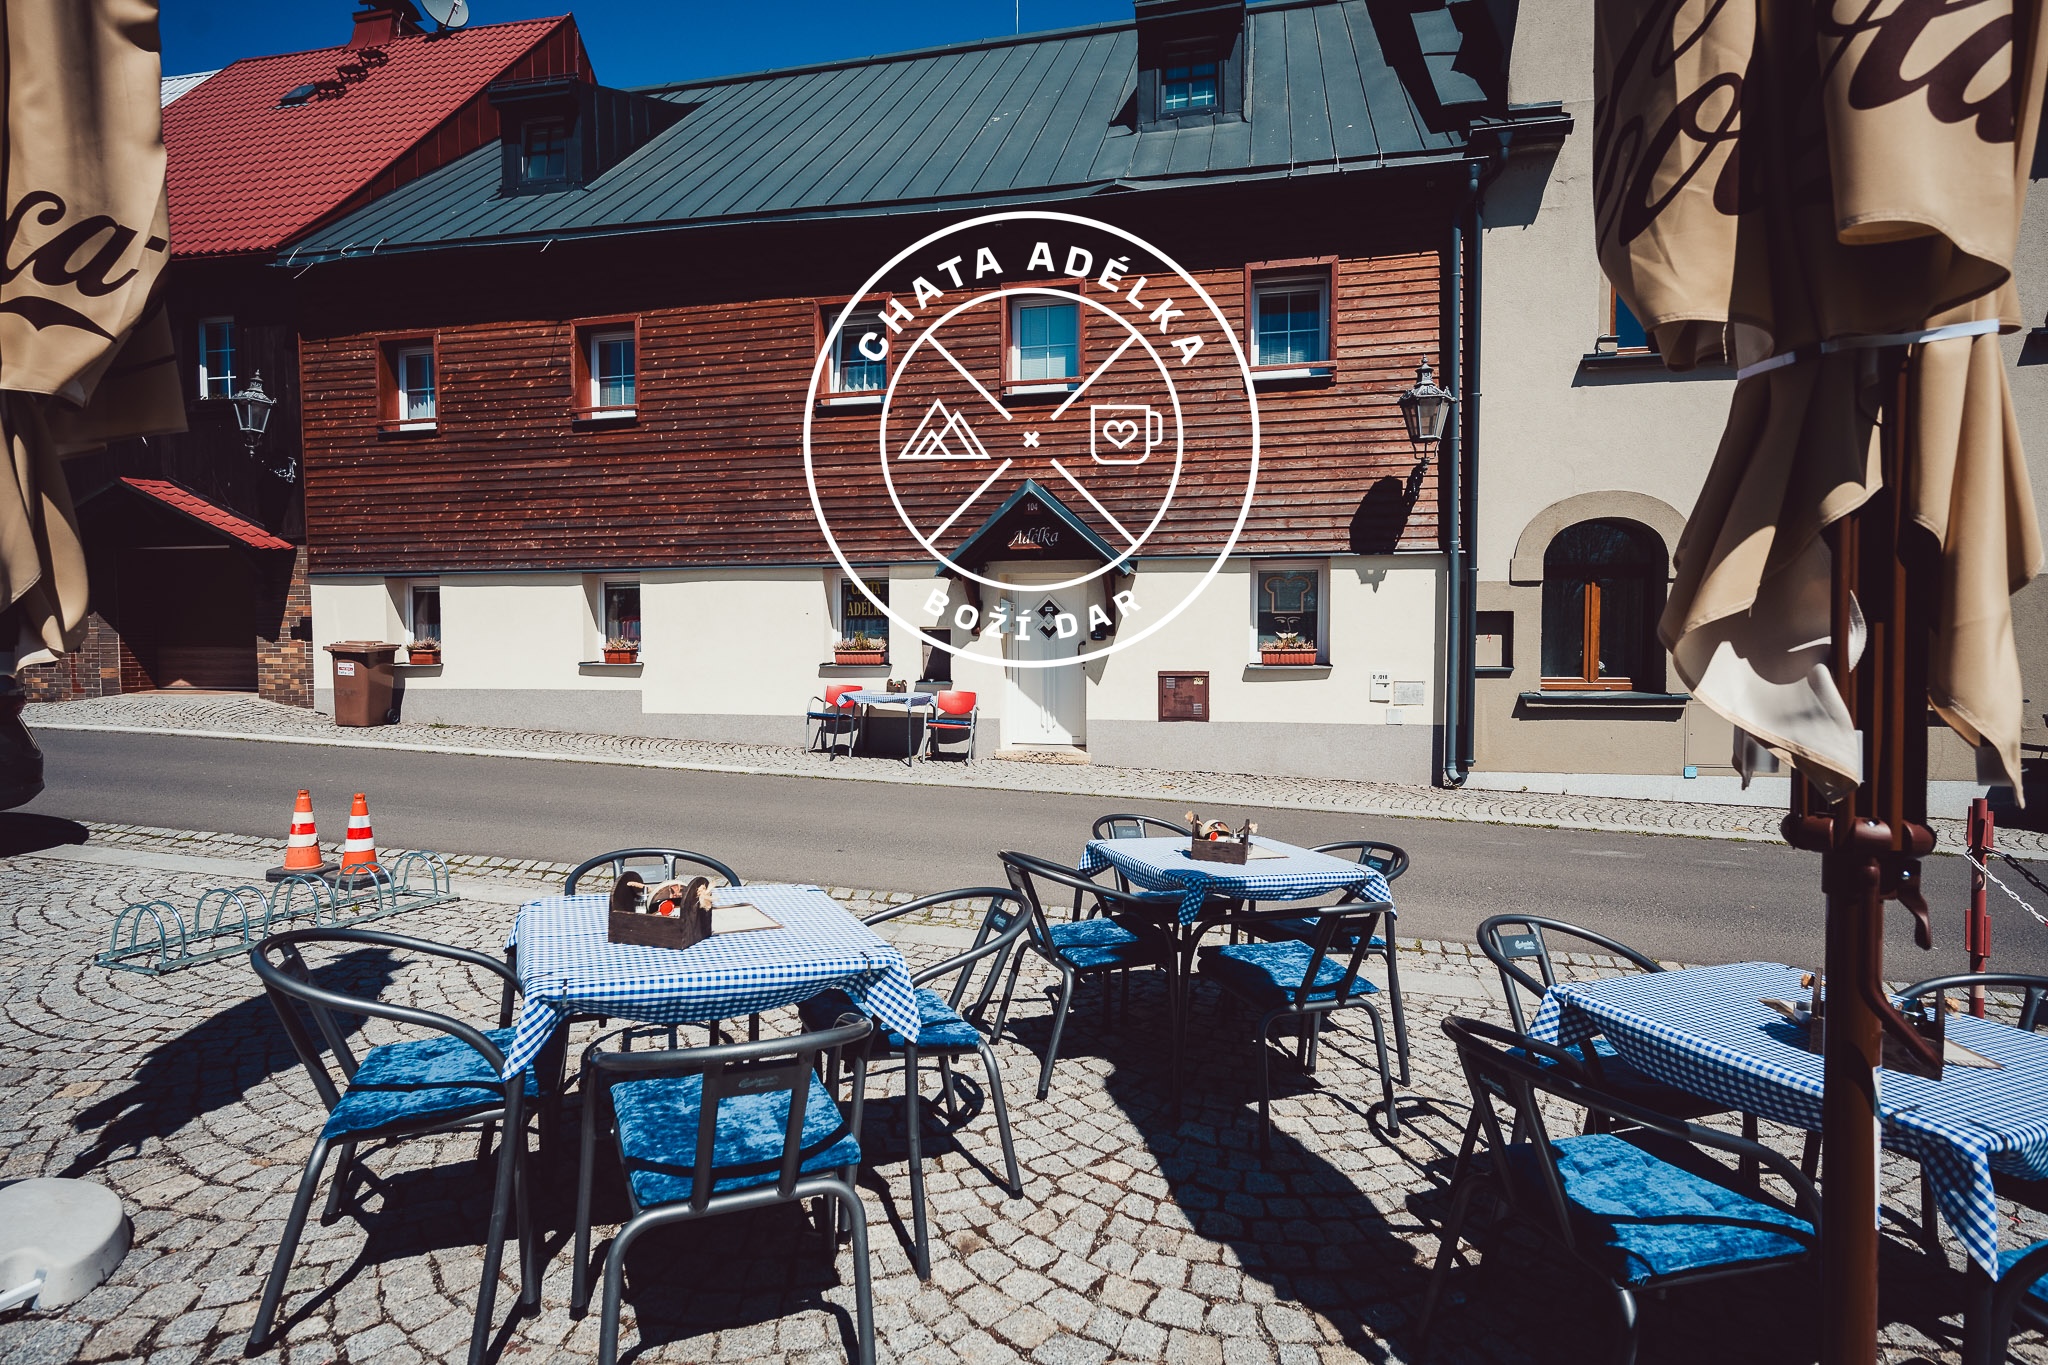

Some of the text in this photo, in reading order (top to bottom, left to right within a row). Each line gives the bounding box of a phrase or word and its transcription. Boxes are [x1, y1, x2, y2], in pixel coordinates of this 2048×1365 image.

[1026, 502, 1039, 511] 104
[1007, 526, 1059, 547] Adélka
[847, 597, 886, 616] ADÉLK
